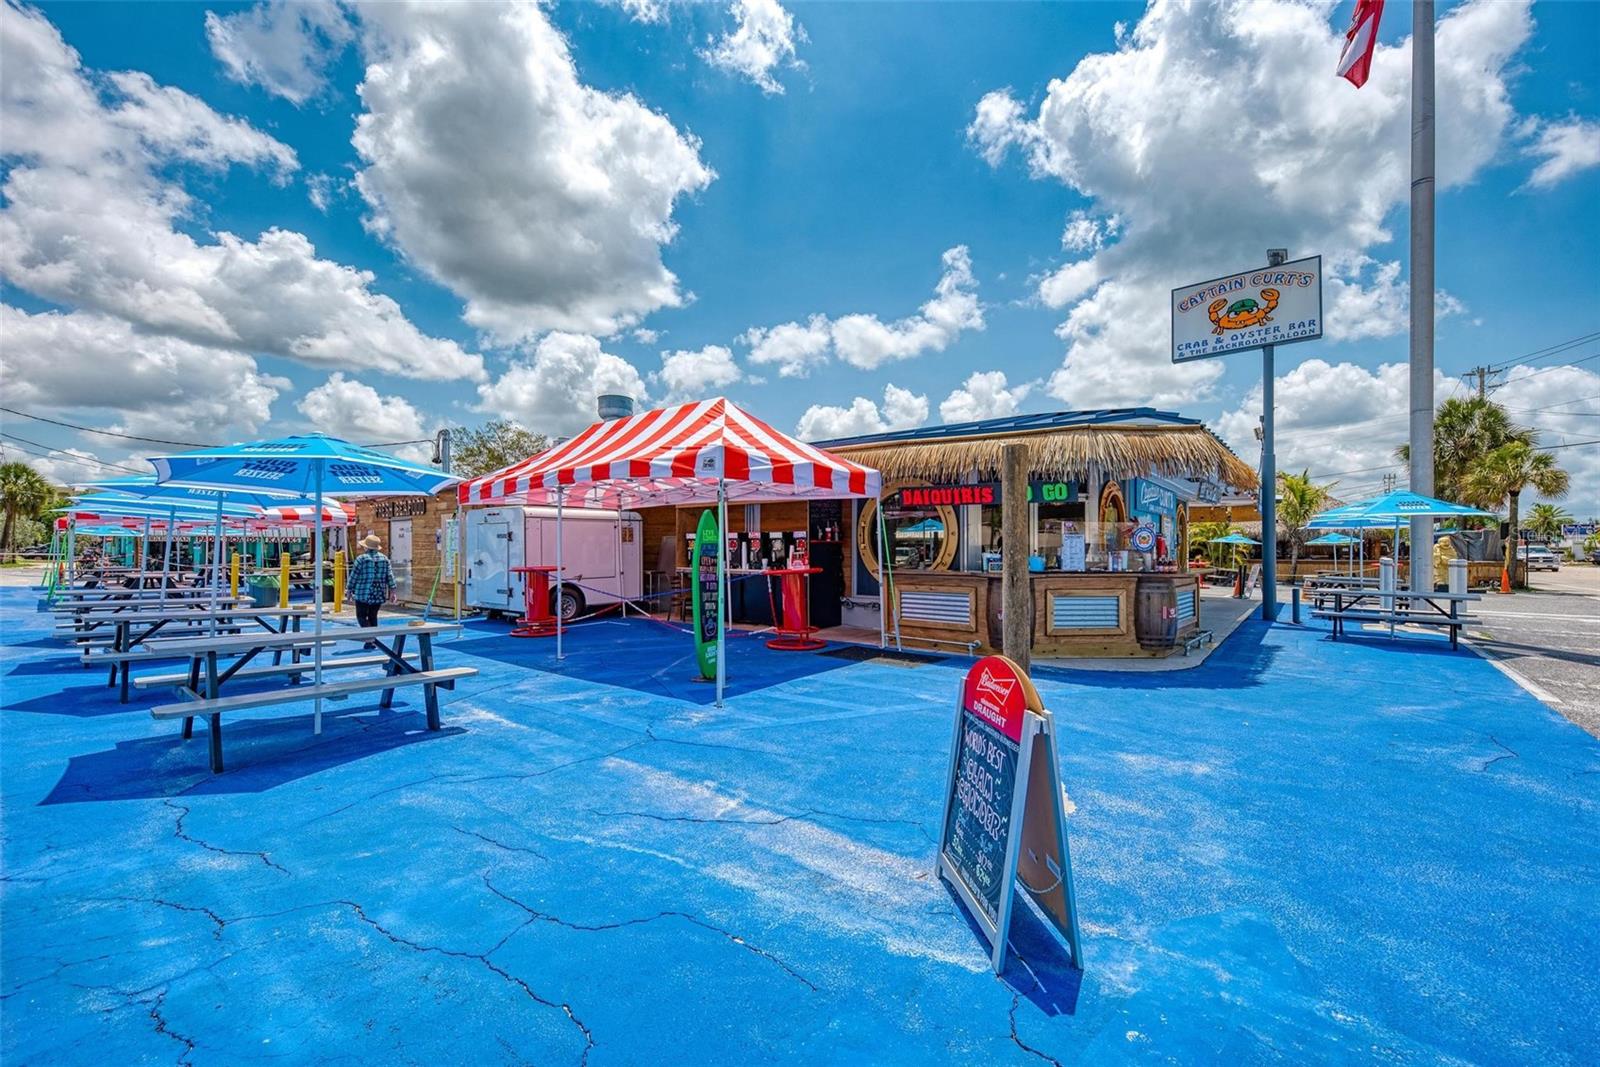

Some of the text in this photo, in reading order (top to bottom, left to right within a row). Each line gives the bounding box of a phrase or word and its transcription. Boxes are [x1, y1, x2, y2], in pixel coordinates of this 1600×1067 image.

[1177, 271, 1314, 313] CAPTAIN CURT'S
[1177, 319, 1316, 351] CRAB & OYSTER BAR
[1190, 347, 1208, 355] THE
[1212, 337, 1267, 352] BACKROOM
[1272, 327, 1316, 340] SALOON
[902, 487, 993, 505] DAIQUIRIS
[1042, 482, 1069, 501] GO
[980, 672, 1009, 696] Budweiser
[973, 700, 1007, 728] DRAUGHT
[986, 740, 1007, 774] BEST
[966, 757, 993, 802] CLAM
[956, 776, 1002, 841] CHOWDER
